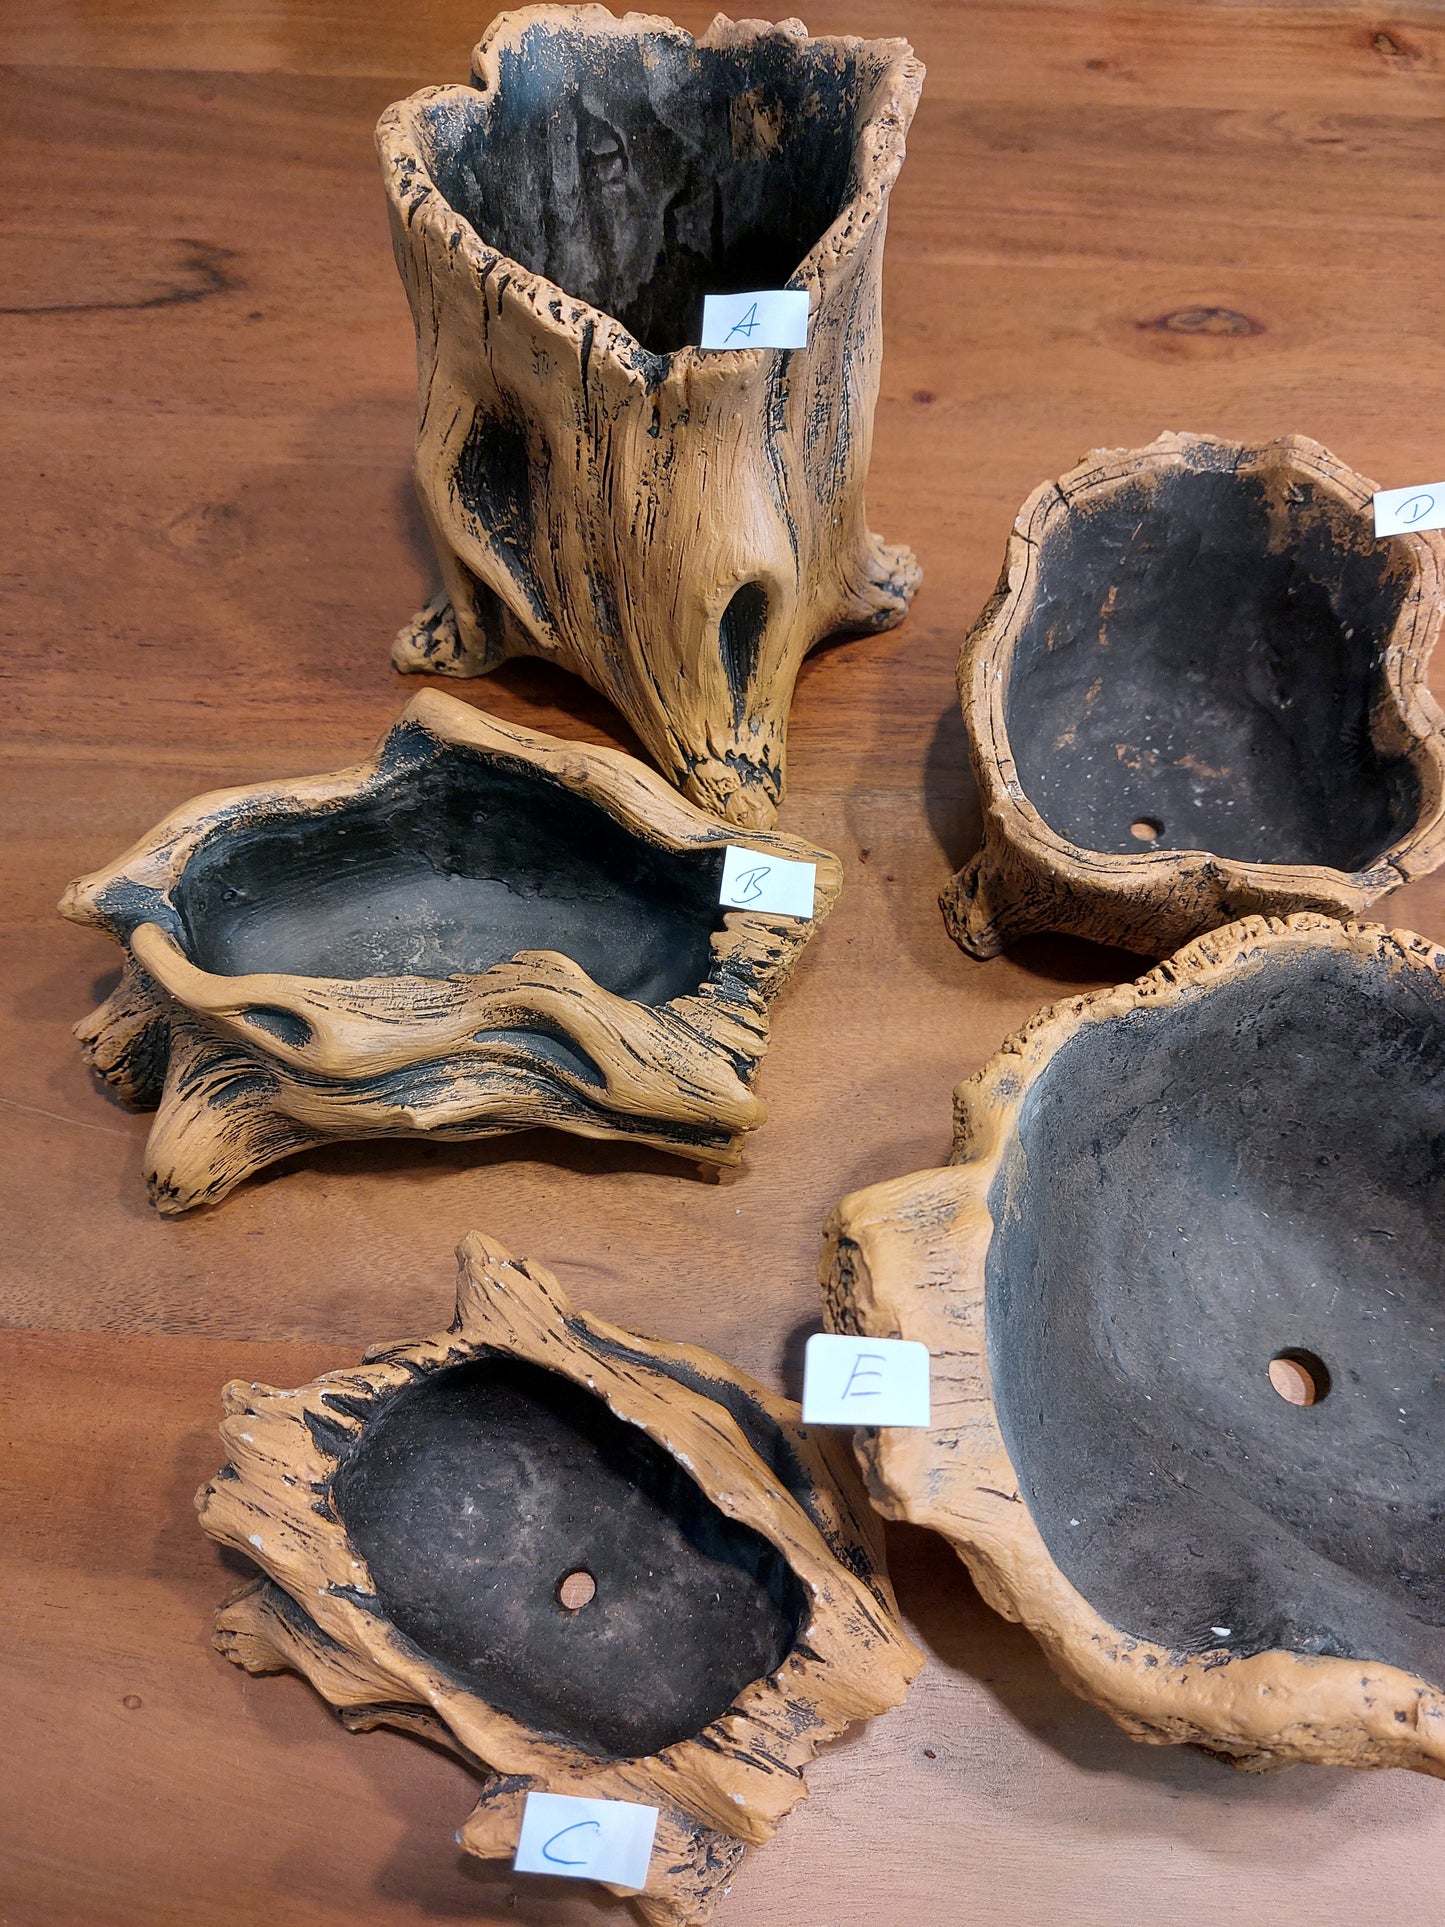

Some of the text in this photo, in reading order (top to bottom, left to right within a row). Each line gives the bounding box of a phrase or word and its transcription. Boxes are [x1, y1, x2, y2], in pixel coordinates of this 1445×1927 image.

[723, 302, 761, 344] A
[1395, 494, 1435, 524] D
[731, 866, 772, 904] B
[841, 1353, 887, 1400] E
[542, 1821, 601, 1865] C
